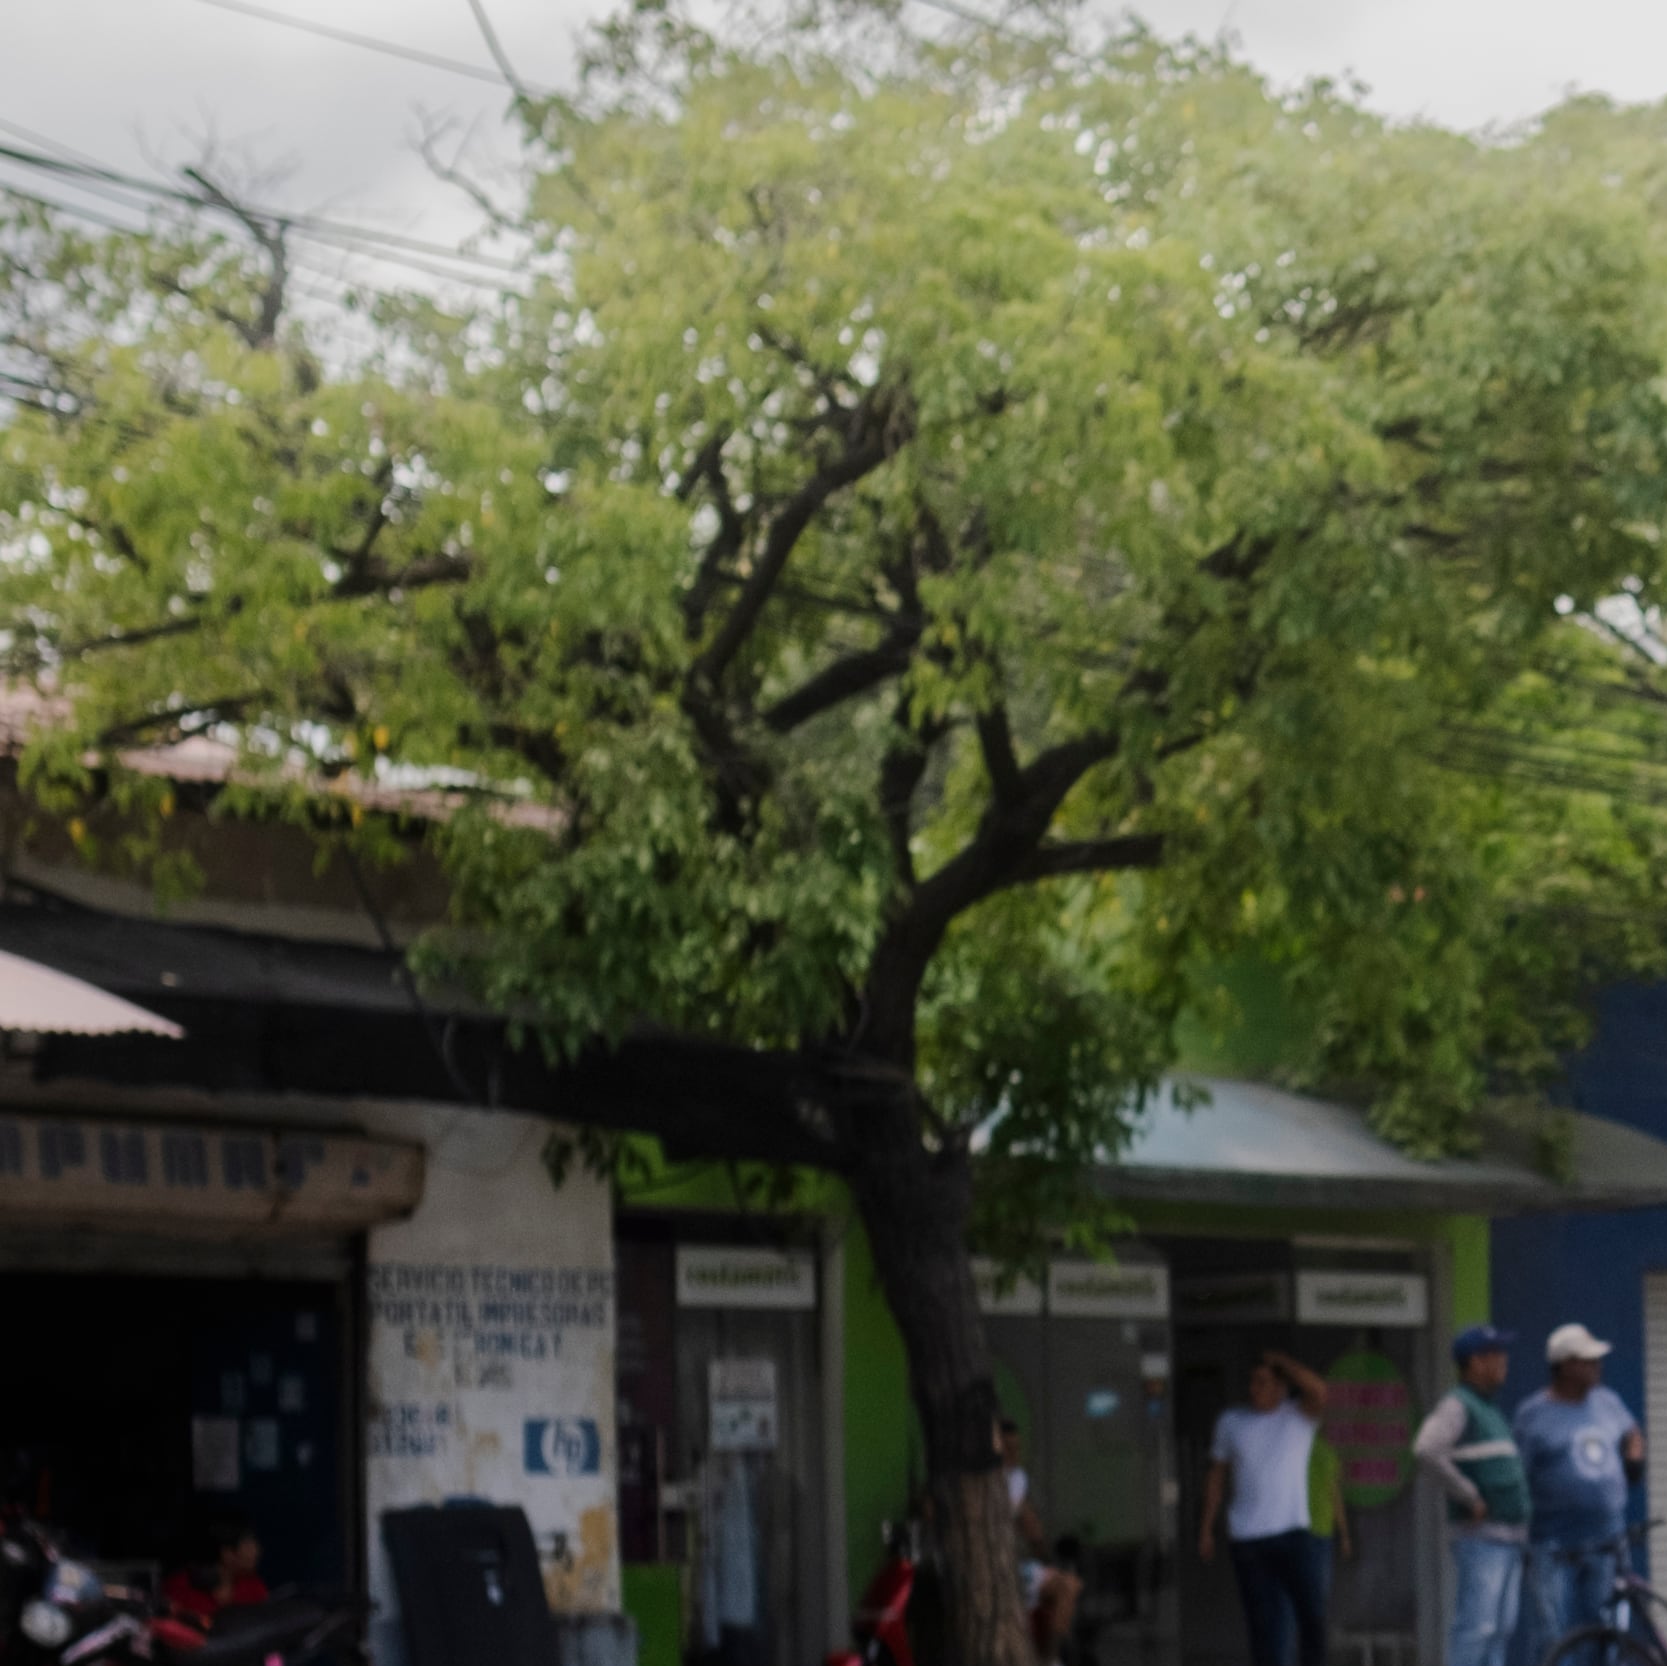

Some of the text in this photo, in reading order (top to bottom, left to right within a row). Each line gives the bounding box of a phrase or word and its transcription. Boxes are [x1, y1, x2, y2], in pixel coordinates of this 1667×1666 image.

[369, 1264, 465, 1292] SERVICIO
[558, 1267, 580, 1295] DE
[479, 1302, 605, 1329] IMPRESORAS
